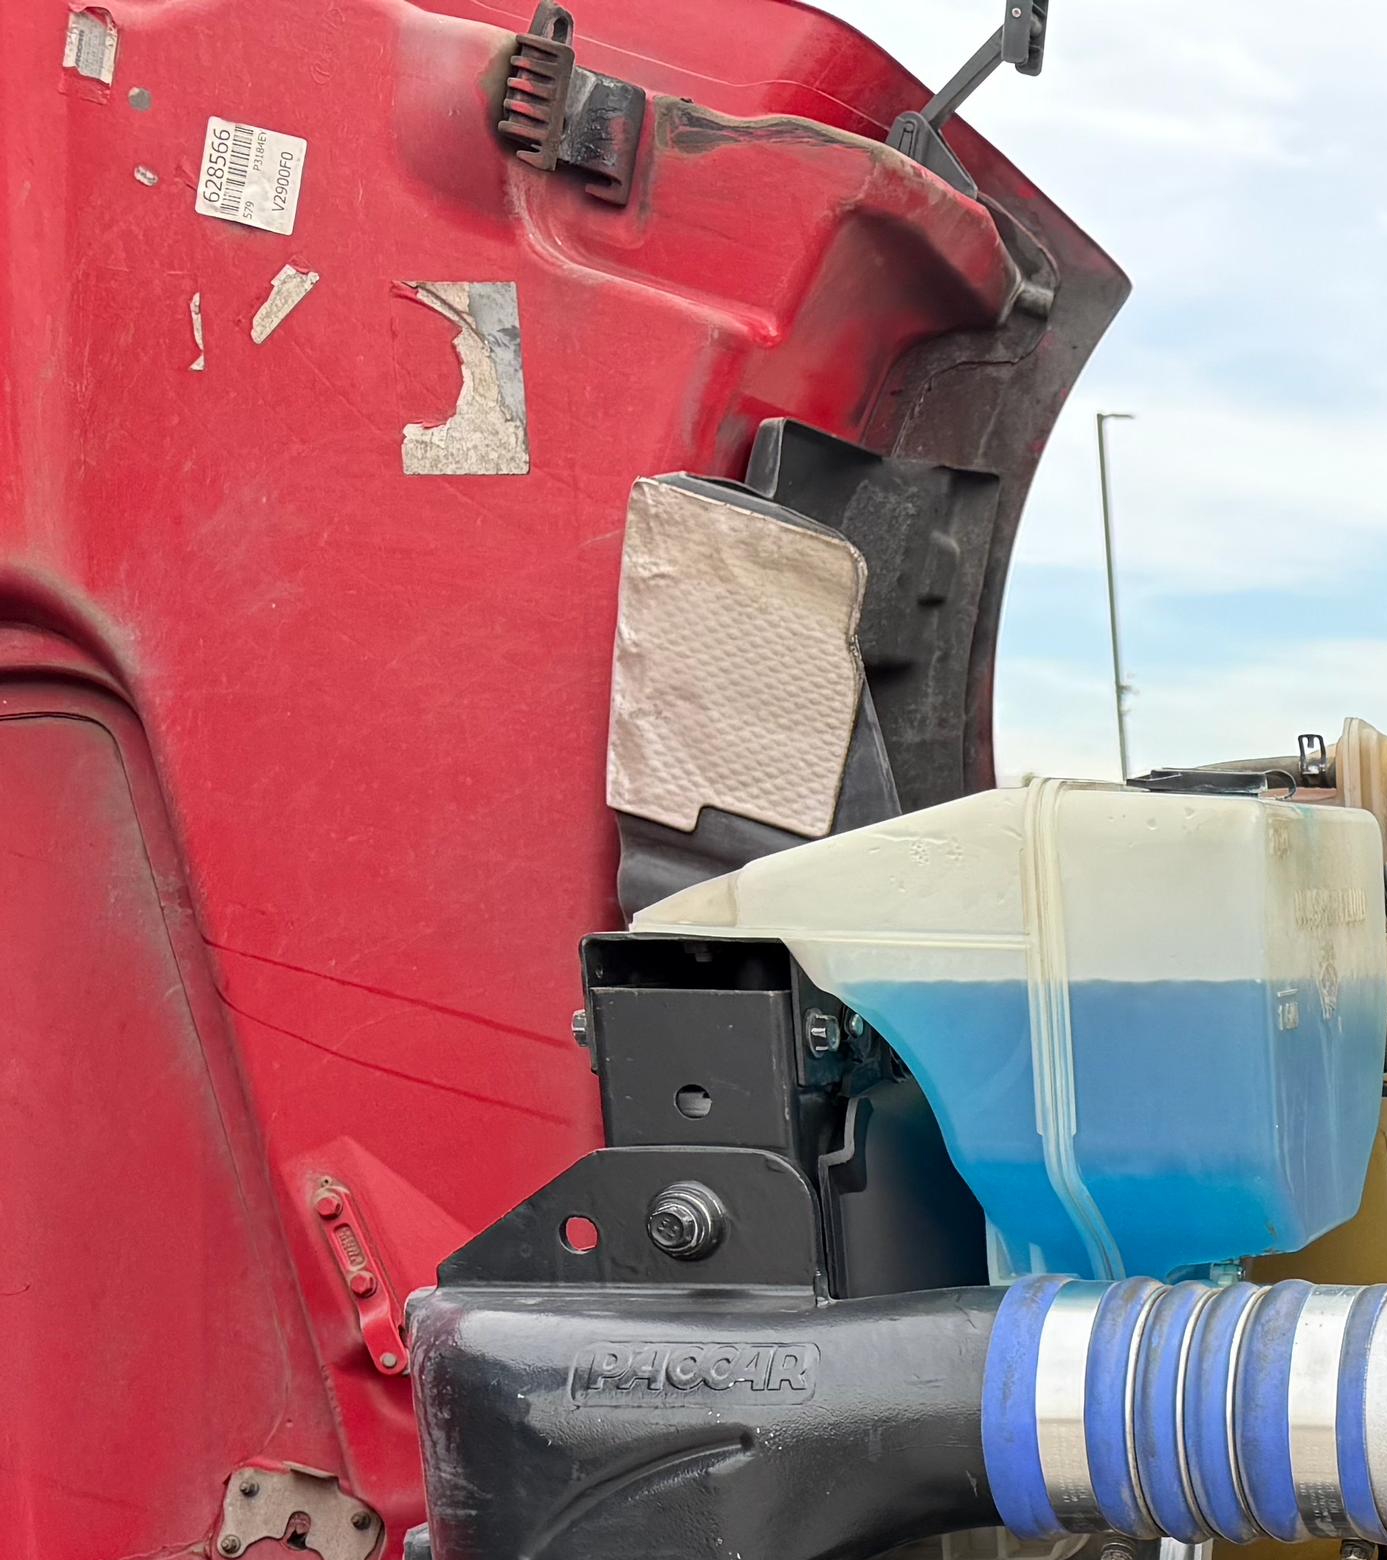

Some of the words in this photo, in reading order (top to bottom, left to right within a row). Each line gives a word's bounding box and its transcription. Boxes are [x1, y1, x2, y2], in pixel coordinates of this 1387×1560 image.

[203, 128, 231, 202] 628566
[243, 201, 254, 219] 579
[586, 1345, 808, 1391] PACCAR
